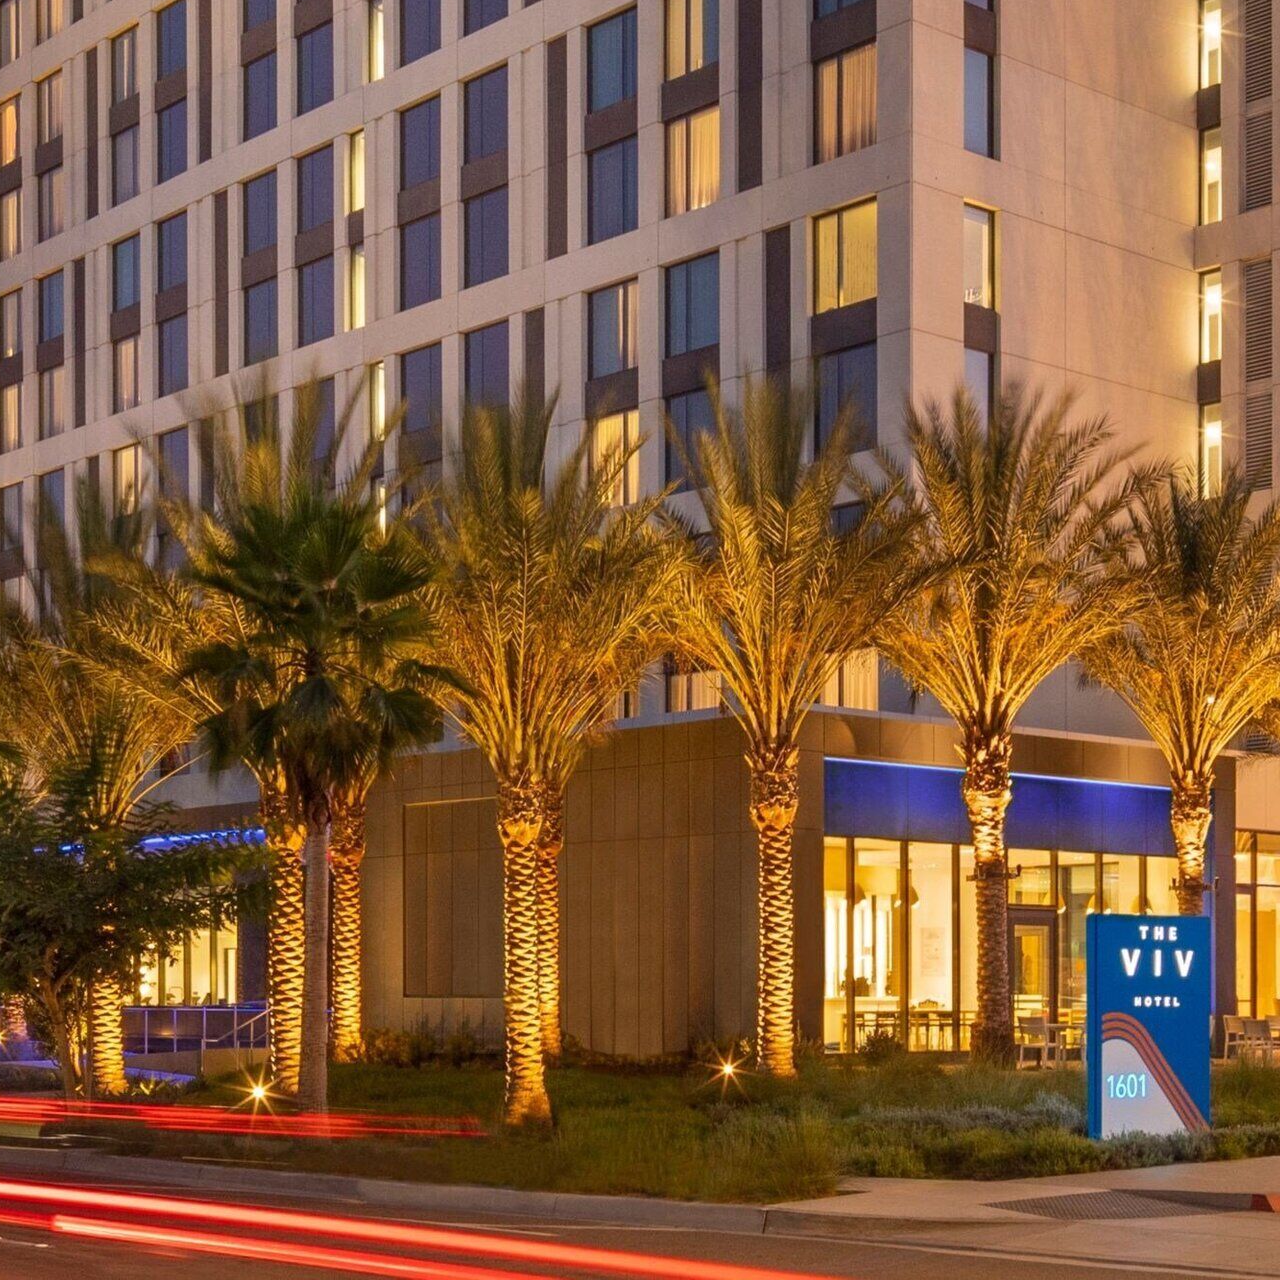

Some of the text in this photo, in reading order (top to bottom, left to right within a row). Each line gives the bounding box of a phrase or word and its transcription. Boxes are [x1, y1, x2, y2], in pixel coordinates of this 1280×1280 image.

[1138, 925, 1178, 941] THE
[1120, 948, 1194, 977] VIV
[1133, 996, 1181, 1008] HOTEL
[1106, 1074, 1147, 1098] 1601
